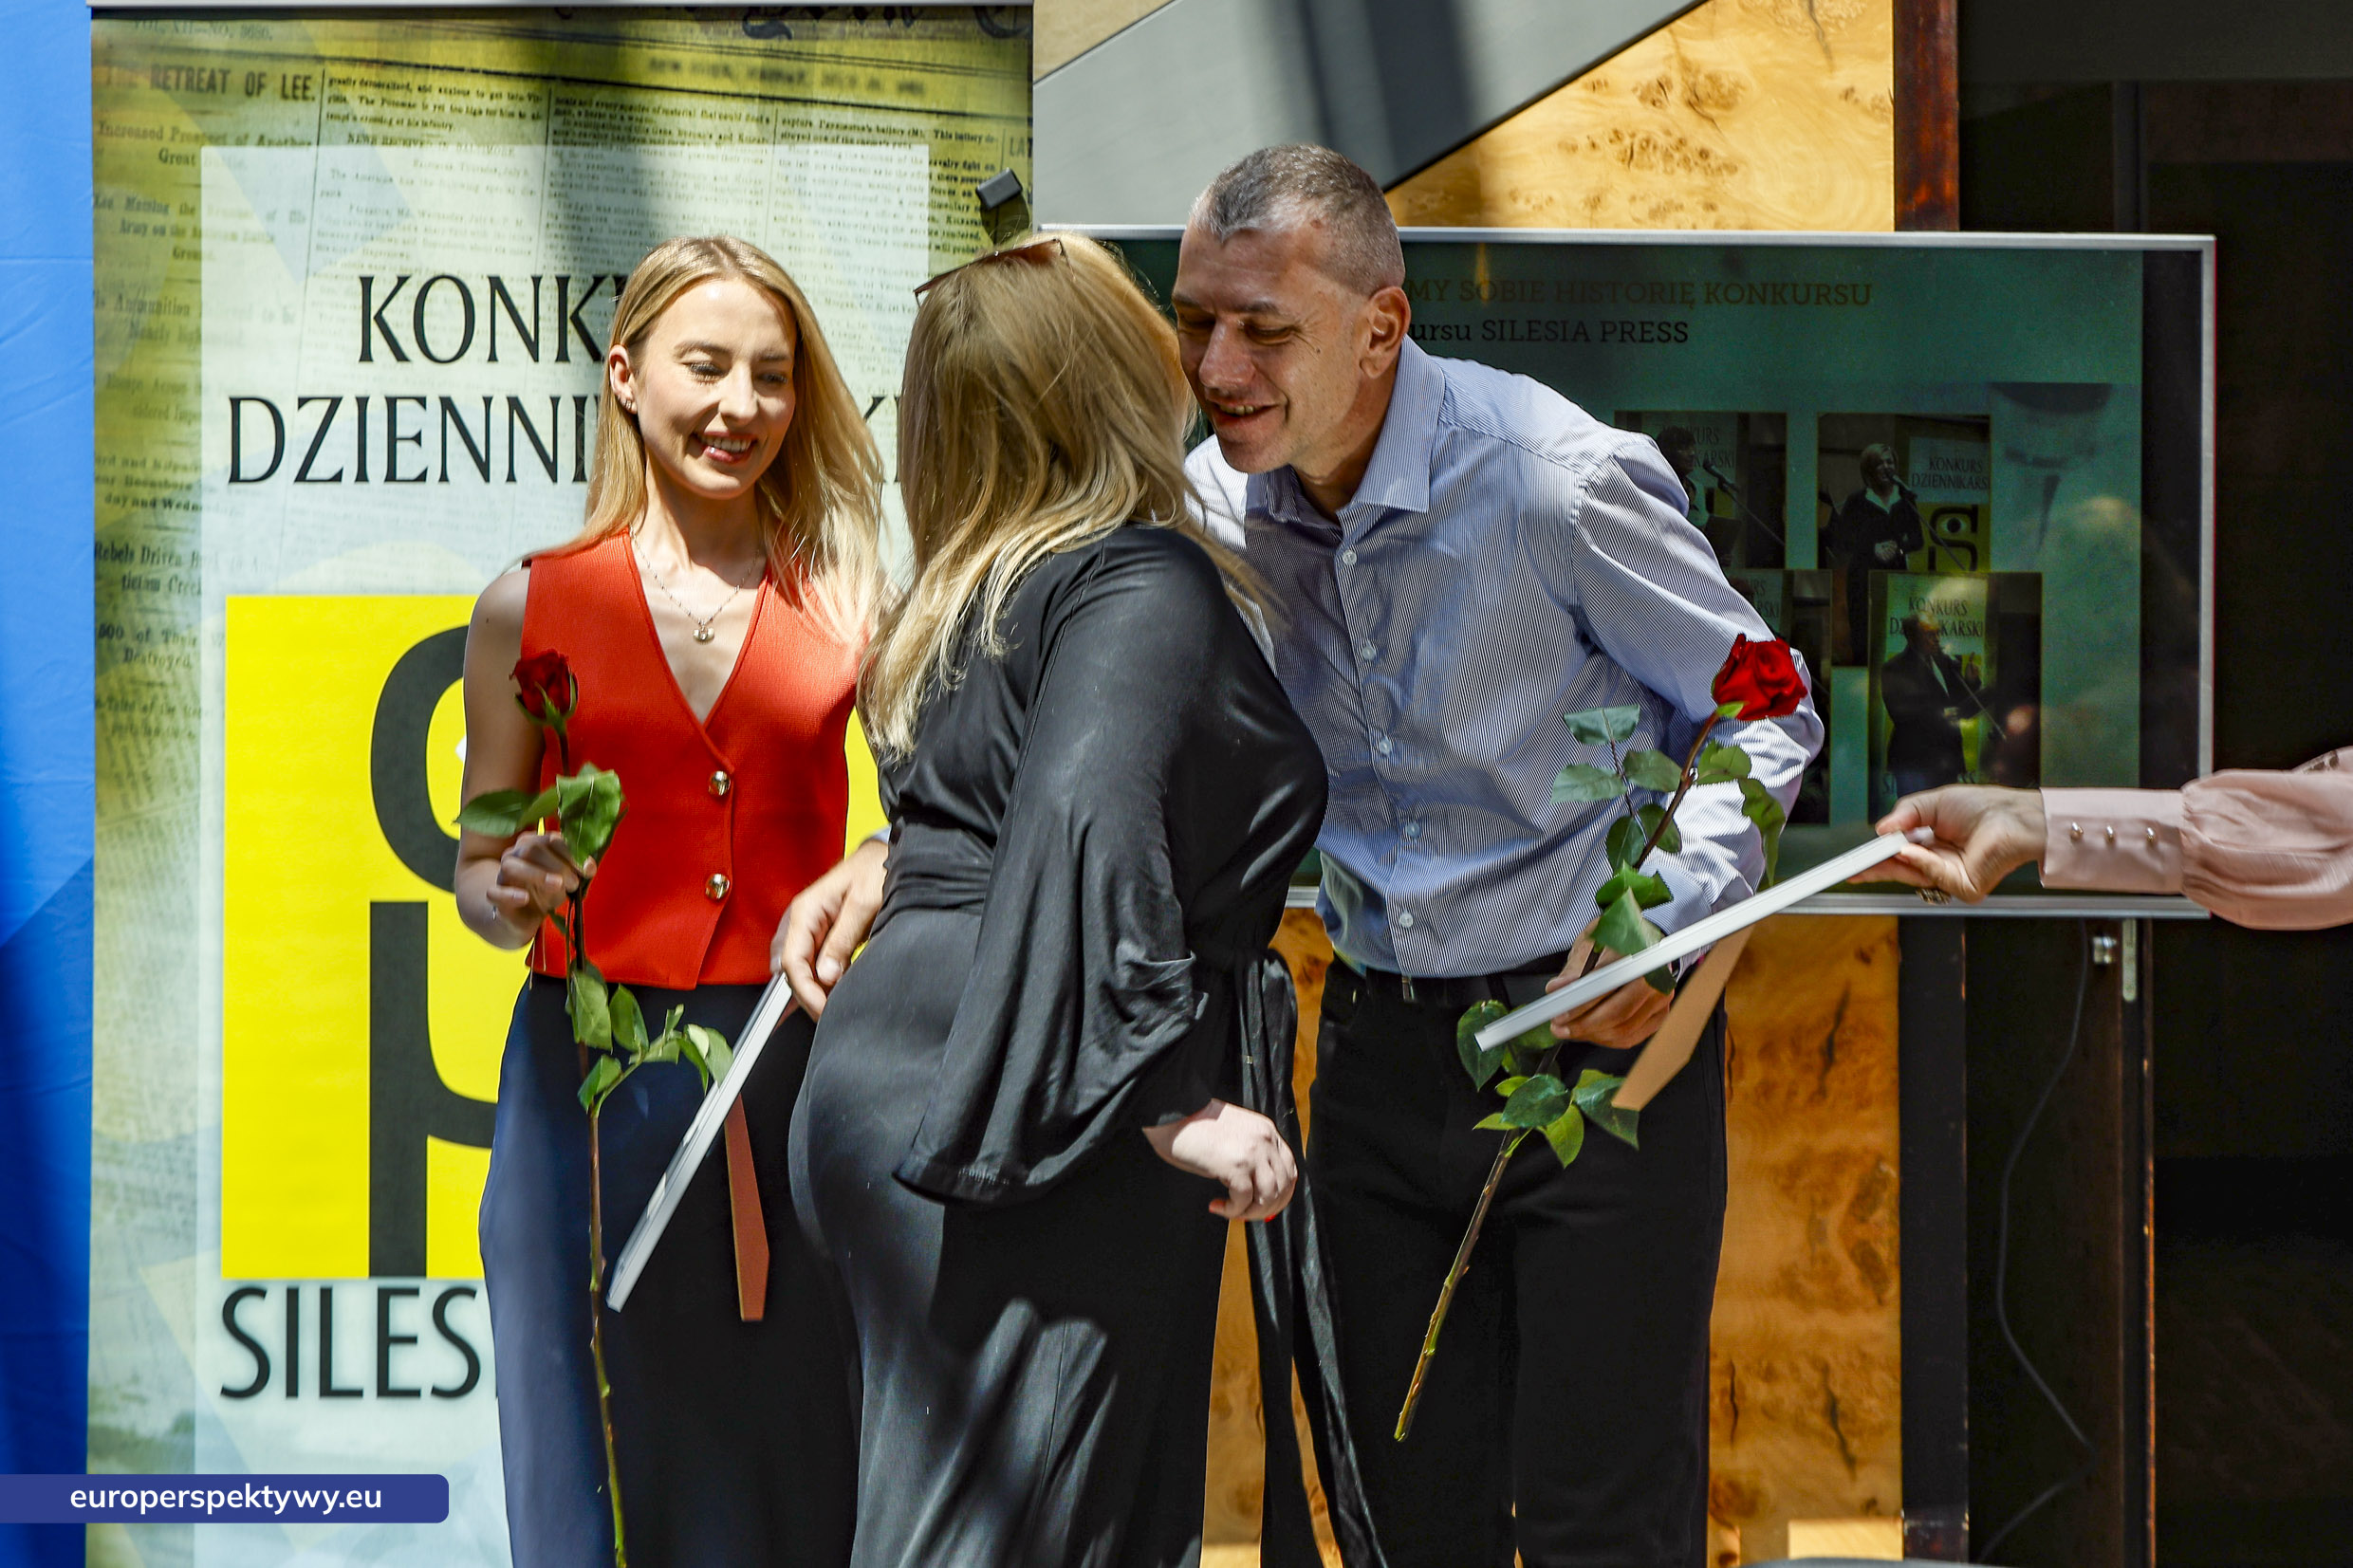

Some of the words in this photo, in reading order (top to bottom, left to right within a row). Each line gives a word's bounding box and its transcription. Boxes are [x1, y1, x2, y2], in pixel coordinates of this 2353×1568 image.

[150, 63, 232, 95] RETREAT
[244, 70, 268, 98] OF
[280, 72, 317, 102] LEE.
[1458, 279, 1546, 304] SOBIE
[1556, 280, 1695, 310] HISTORIĘ
[1704, 282, 1873, 306] KONKURSU
[359, 275, 628, 363] KONK
[1481, 320, 1590, 342] SILESIA
[1601, 320, 1689, 343] PRESS
[229, 396, 602, 484] DZIENNI
[1928, 455, 1984, 474] KONKURS
[1907, 596, 1969, 617] KONKURS
[220, 1286, 497, 1400] SILES
